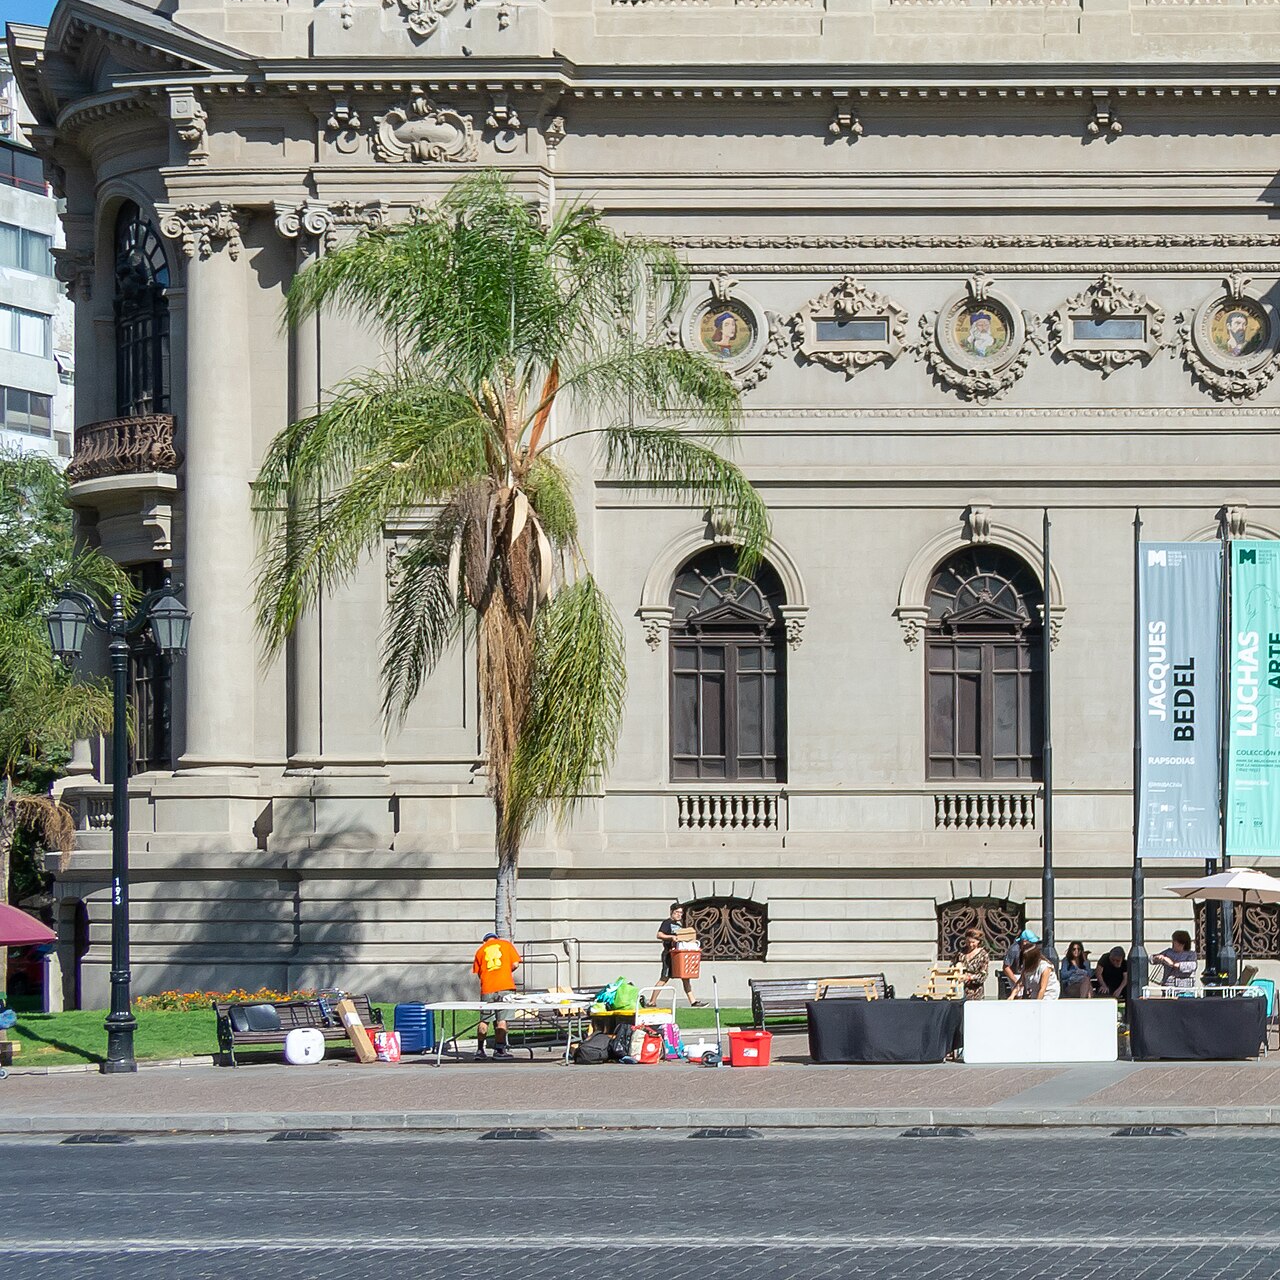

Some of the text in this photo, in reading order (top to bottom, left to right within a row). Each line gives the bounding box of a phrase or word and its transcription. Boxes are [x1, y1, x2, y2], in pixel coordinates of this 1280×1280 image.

[1148, 620, 1170, 722] JACQUES
[1173, 656, 1195, 741] BEDEL
[1235, 630, 1259, 737] LUCHAS
[1148, 756, 1195, 766] RAPSODIAS
